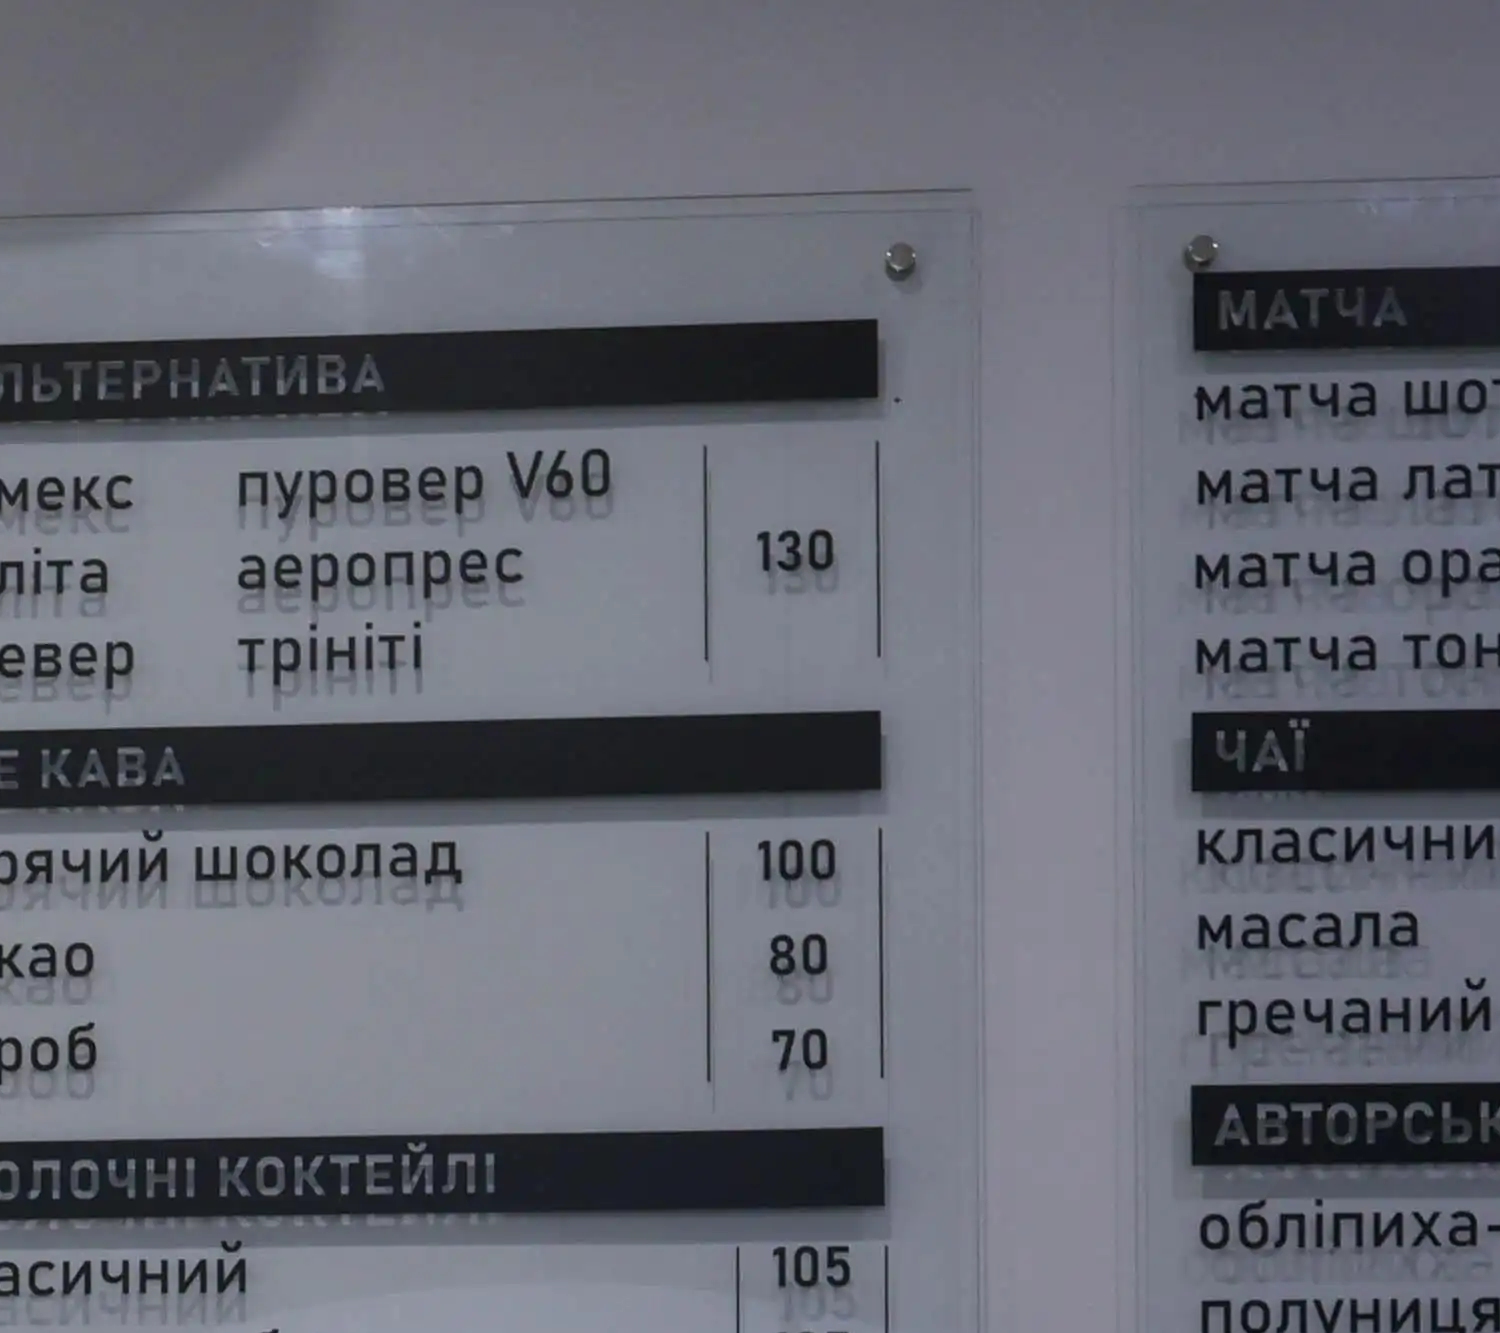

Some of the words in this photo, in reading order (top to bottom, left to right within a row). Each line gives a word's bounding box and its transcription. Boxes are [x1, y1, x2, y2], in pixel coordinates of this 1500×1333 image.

[1217, 289, 1408, 332] МАТЧА
[1195, 382, 1376, 421] матча
[239, 465, 483, 520] пуровер
[506, 448, 610, 499] V60
[1197, 466, 1377, 505] матча
[757, 529, 834, 572] 130
[1195, 550, 1375, 590] матча
[238, 548, 523, 603] аеропрес
[238, 621, 422, 687] трініті
[1196, 635, 1377, 675] матча
[1215, 718, 1310, 773] ЧАЇ
[41, 747, 185, 789] КАВА
[195, 841, 463, 886] шоколад
[1198, 911, 1419, 950] масала
[770, 933, 827, 977] 80
[1199, 977, 1491, 1050] гречаний
[218, 1142, 497, 1197] КОКТЕЙЛІ
[773, 1246, 850, 1288] 105
